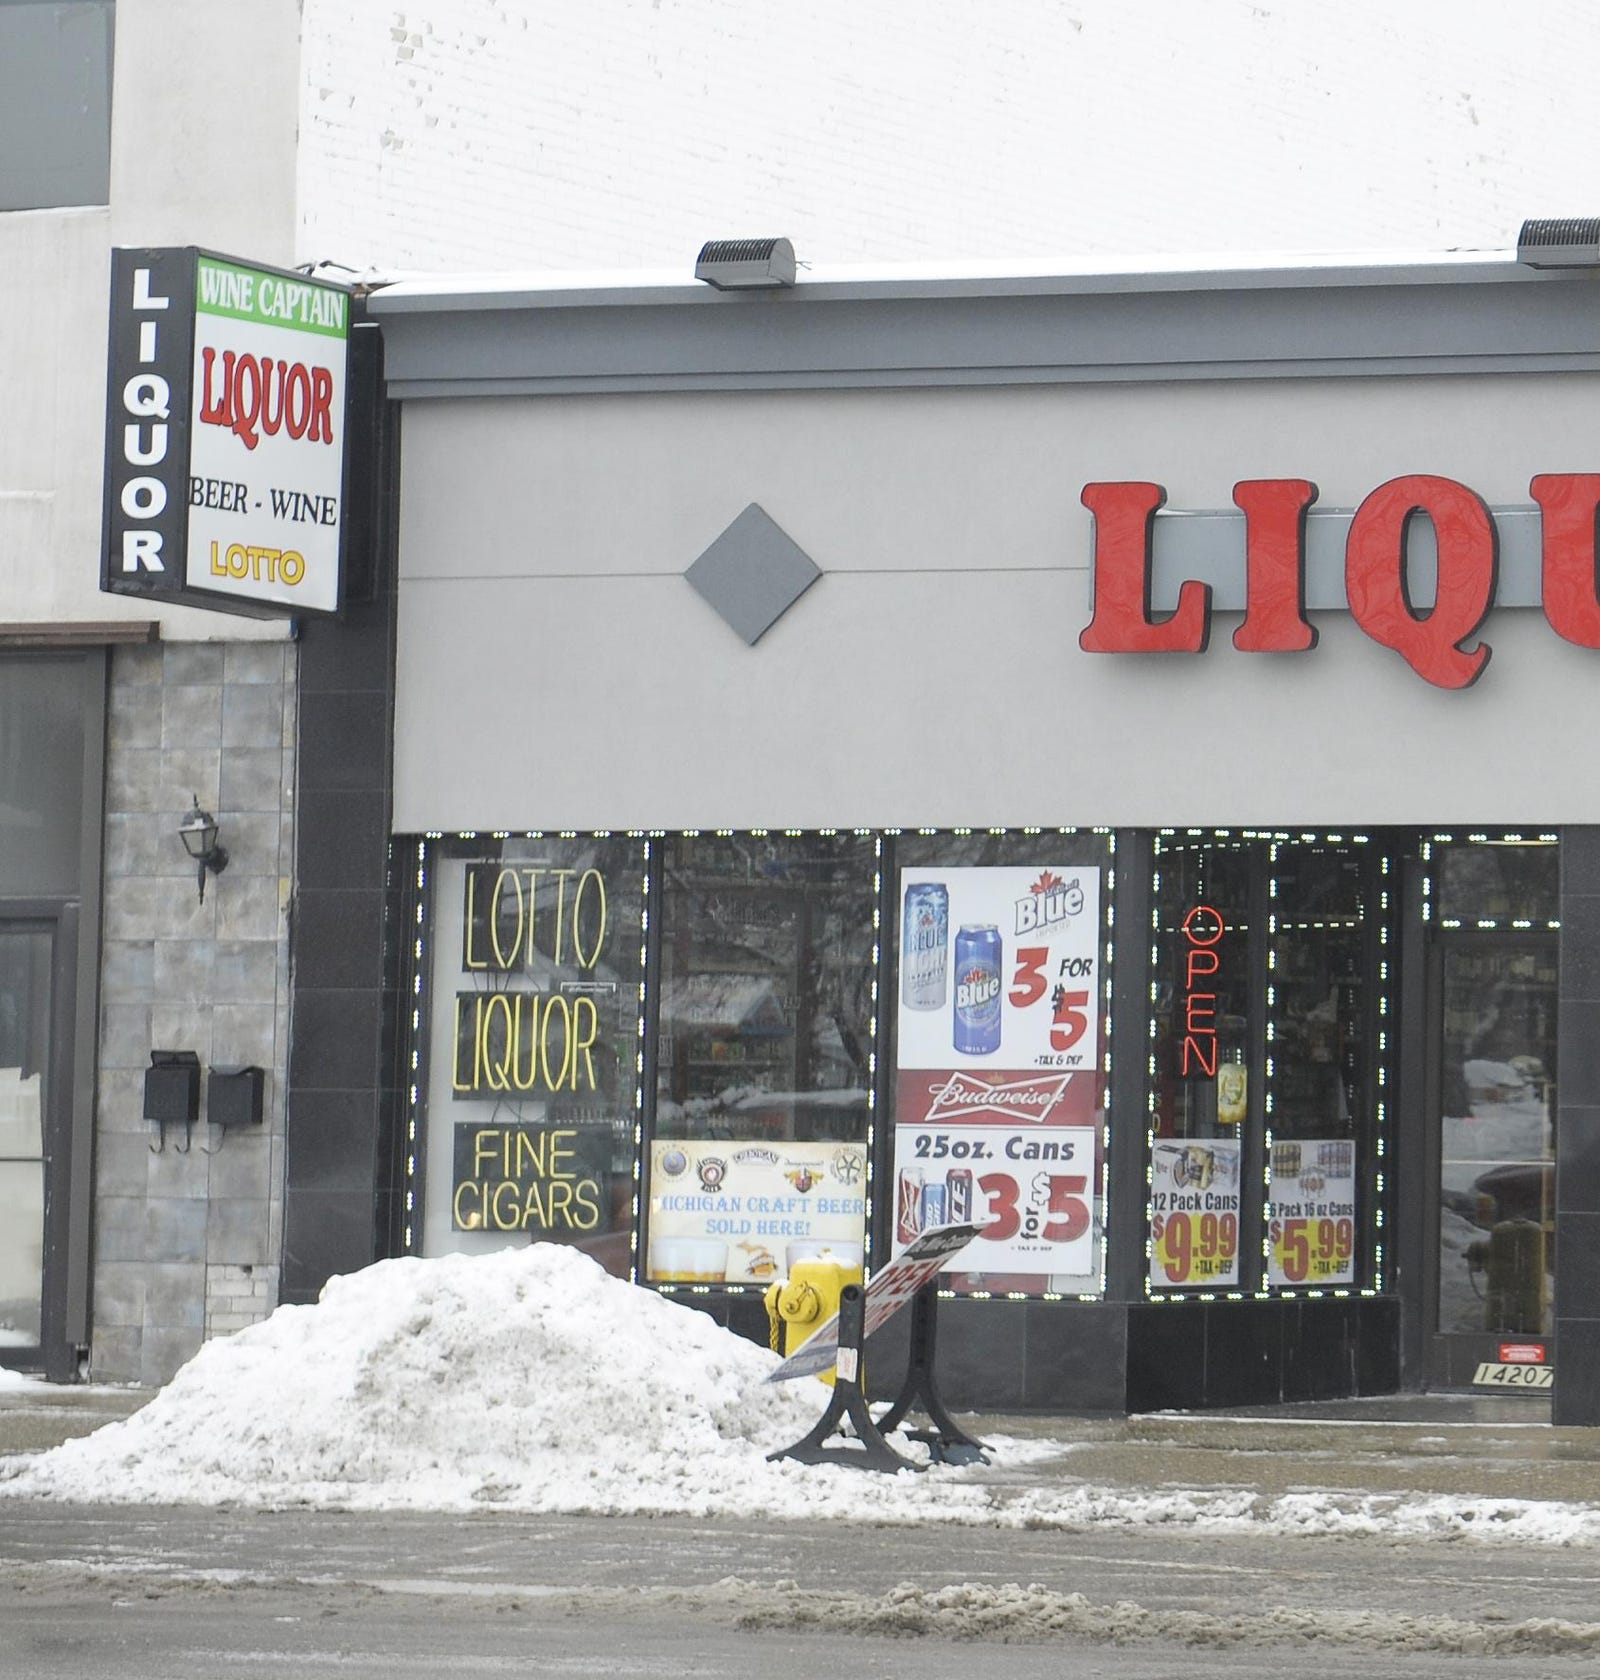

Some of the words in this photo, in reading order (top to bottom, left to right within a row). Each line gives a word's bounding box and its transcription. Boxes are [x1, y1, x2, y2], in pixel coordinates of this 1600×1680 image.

[201, 266, 253, 312] WINE
[259, 279, 345, 329] CAPTAIN
[121, 268, 170, 572] LIQUOR
[200, 346, 333, 451] LIQUOR
[189, 476, 248, 514] BEER
[270, 489, 336, 526] WINE
[210, 540, 305, 585] LOTTO
[467, 868, 606, 970] LOTTO
[1015, 887, 1084, 936] Blue
[957, 977, 1000, 1008] Blue
[1008, 947, 1049, 1008] 3
[1059, 957, 1093, 977] FOR
[1183, 906, 1223, 1076] OPEN
[452, 995, 598, 1091] LIQUOR
[929, 1084, 1064, 1107] Budweiser
[474, 1130, 577, 1179] FINE
[915, 1135, 993, 1159] 25oz.
[1006, 1136, 1075, 1160] Cans
[454, 1181, 599, 1231] CIGARS
[706, 1219, 749, 1234] SOLD
[757, 1220, 811, 1235] HERE!
[747, 1198, 810, 1213] CRAFT
[817, 1198, 864, 1214] BEER
[977, 1173, 1021, 1241] 3
[1021, 1206, 1039, 1240] for
[1031, 1171, 1090, 1242] $5
[1153, 1193, 1167, 1210] 12
[1170, 1193, 1202, 1211] Pack
[1205, 1193, 1238, 1211] Cans
[1278, 1203, 1301, 1217] Pack
[1304, 1203, 1315, 1216] 16
[1329, 1202, 1353, 1216] Cans
[1153, 1212, 1237, 1283] $9.99
[1270, 1218, 1352, 1282] $5.99
[1480, 1365, 1554, 1385] 14207
